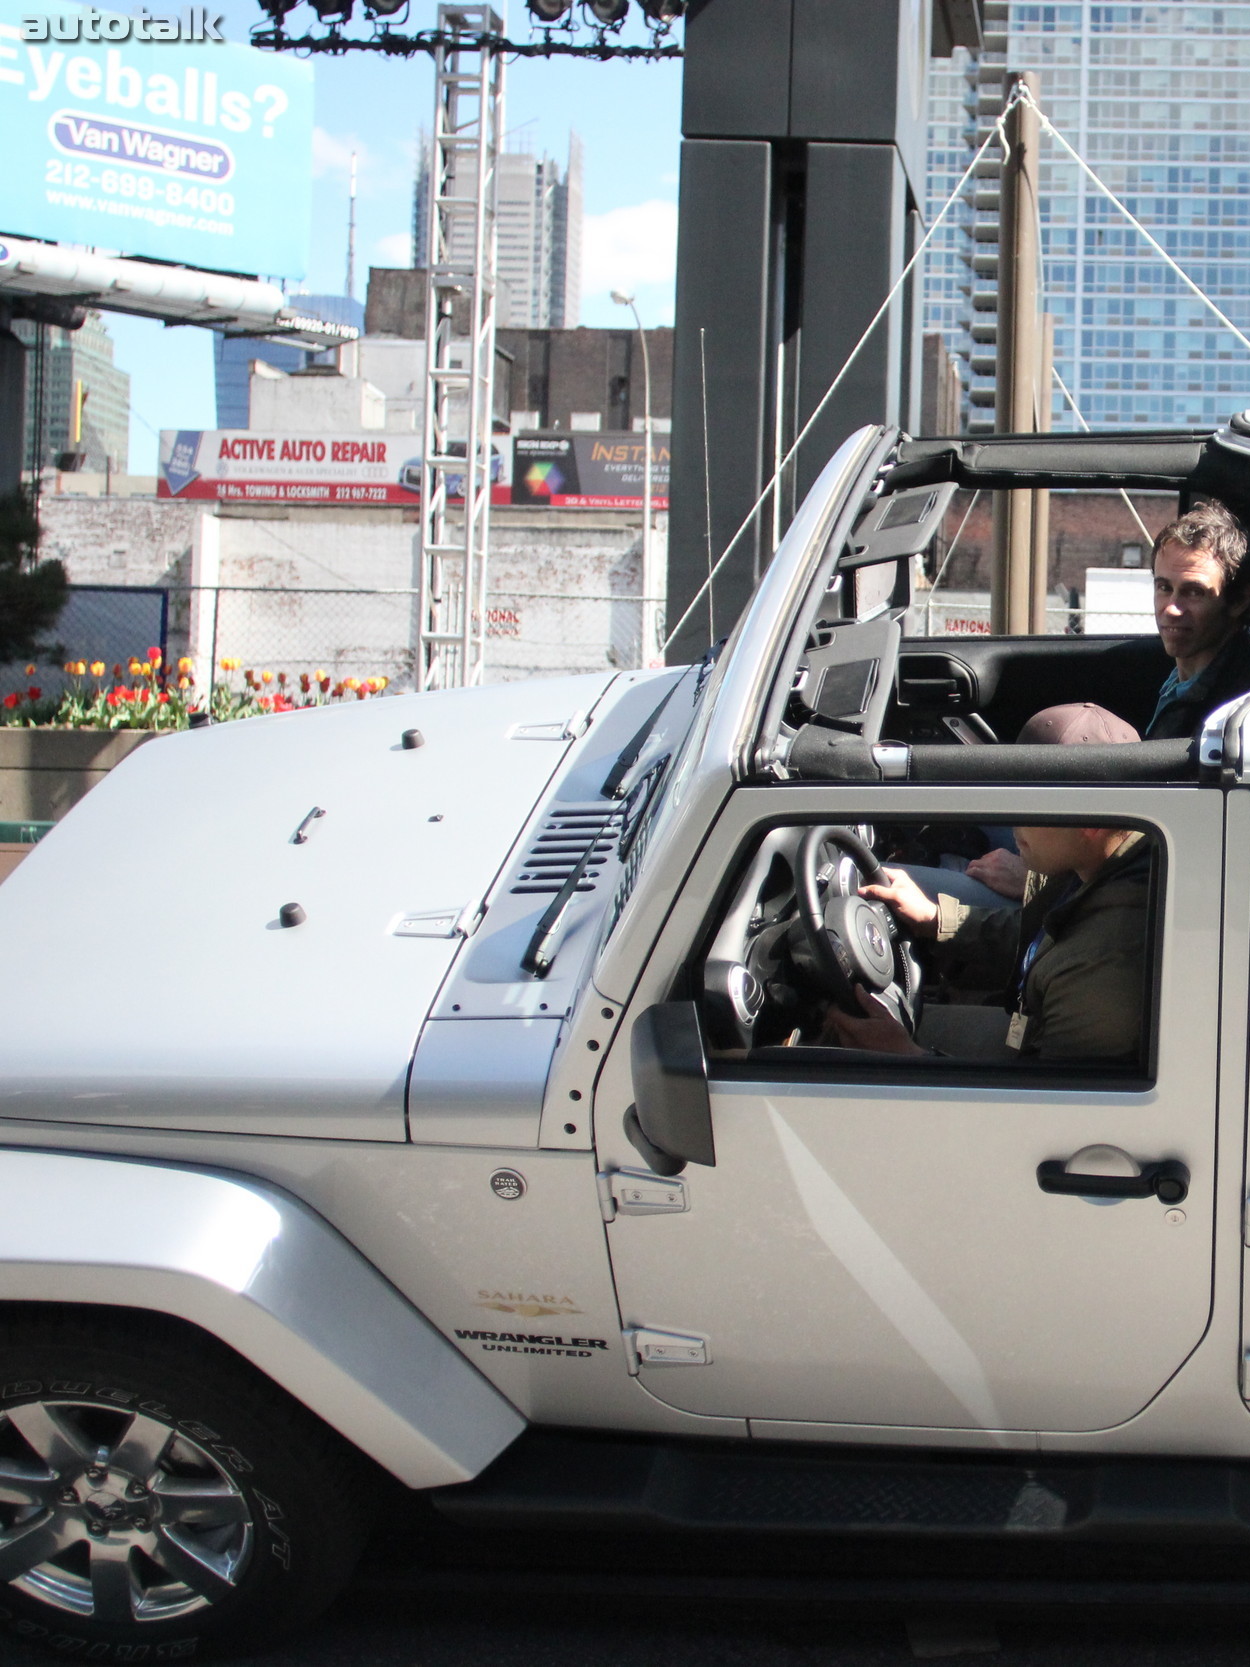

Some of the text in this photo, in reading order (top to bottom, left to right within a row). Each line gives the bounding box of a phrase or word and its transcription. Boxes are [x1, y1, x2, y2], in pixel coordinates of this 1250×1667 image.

[60, 117, 225, 173] Van Wagner
[44, 189, 235, 235] www.vanwagner.com
[219, 438, 275, 461] ACTIVE
[280, 439, 326, 462] AUTO
[332, 440, 387, 463] REPAIR
[245, 486, 277, 498] TOWING
[287, 486, 329, 499] LOCKSMITH
[477, 1290, 575, 1305] SAHARA
[454, 1329, 609, 1350] WRANGLER
[482, 1344, 592, 1358] UNLIMITED
